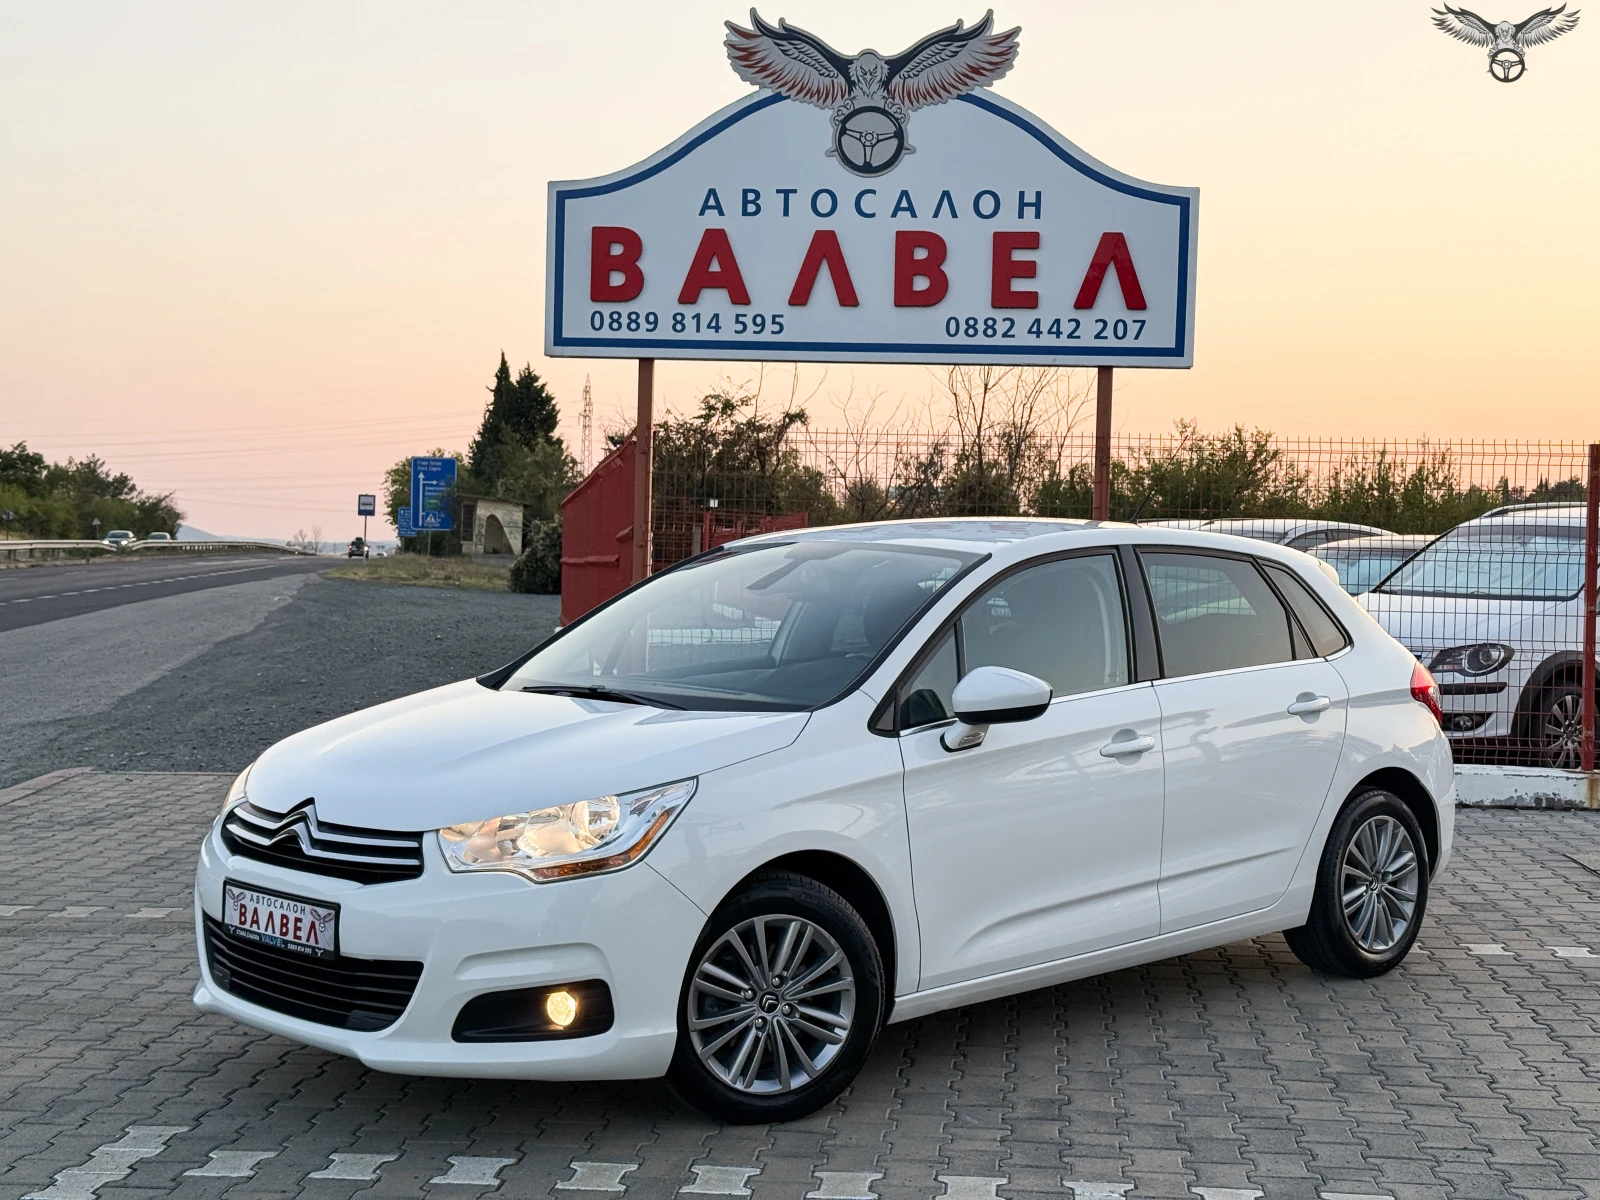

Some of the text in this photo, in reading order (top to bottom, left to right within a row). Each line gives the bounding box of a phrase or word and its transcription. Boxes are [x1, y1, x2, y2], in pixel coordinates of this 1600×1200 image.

[698, 187, 1042, 220] АВТОСАЛОН
[590, 226, 1148, 311] ВАЛВЕЛ
[590, 311, 785, 335] 0889 814 595
[945, 316, 1147, 341] 0882 442 207
[249, 893, 306, 915] АВТОСАЛОН
[238, 903, 319, 945] ВАЛВЕЛ
[261, 933, 285, 948] VALVEL
